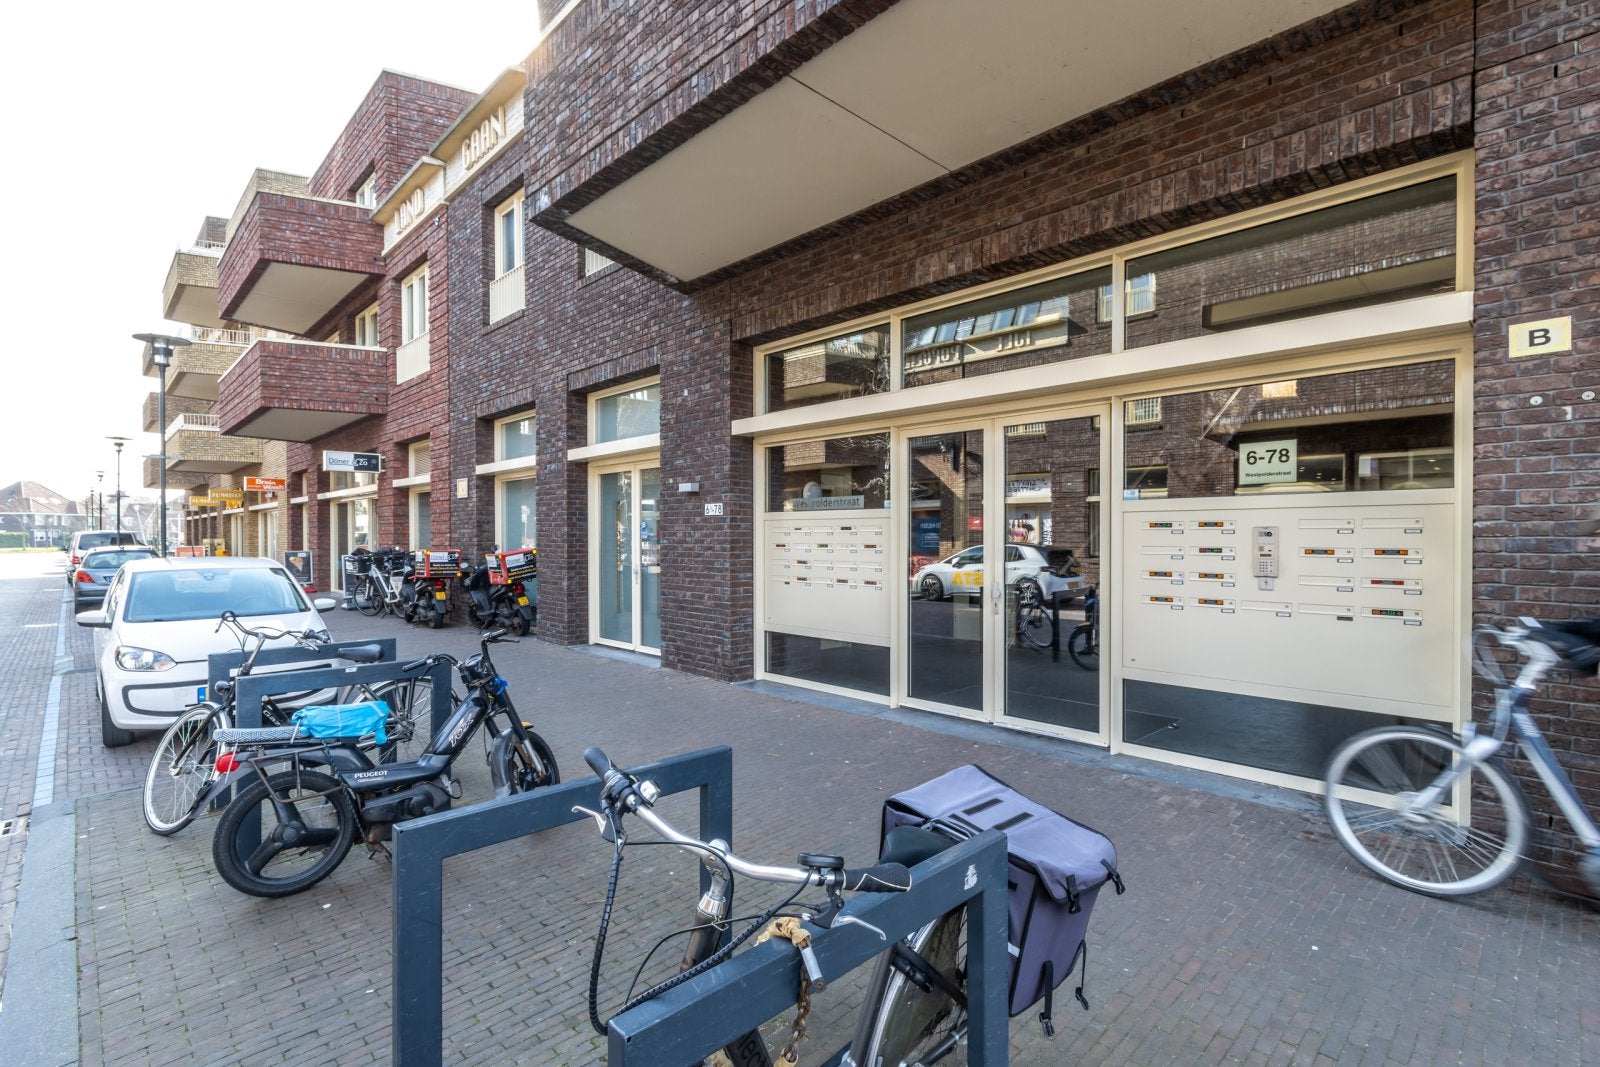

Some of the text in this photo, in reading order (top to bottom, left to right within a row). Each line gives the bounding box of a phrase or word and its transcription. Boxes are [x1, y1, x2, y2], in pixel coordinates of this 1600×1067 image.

[462, 106, 506, 171] GAAN
[1528, 328, 1551, 348] B
[1246, 448, 1290, 465] 6-78
[255, 478, 276, 486] Brain
[354, 770, 388, 779] PEUGEOT
